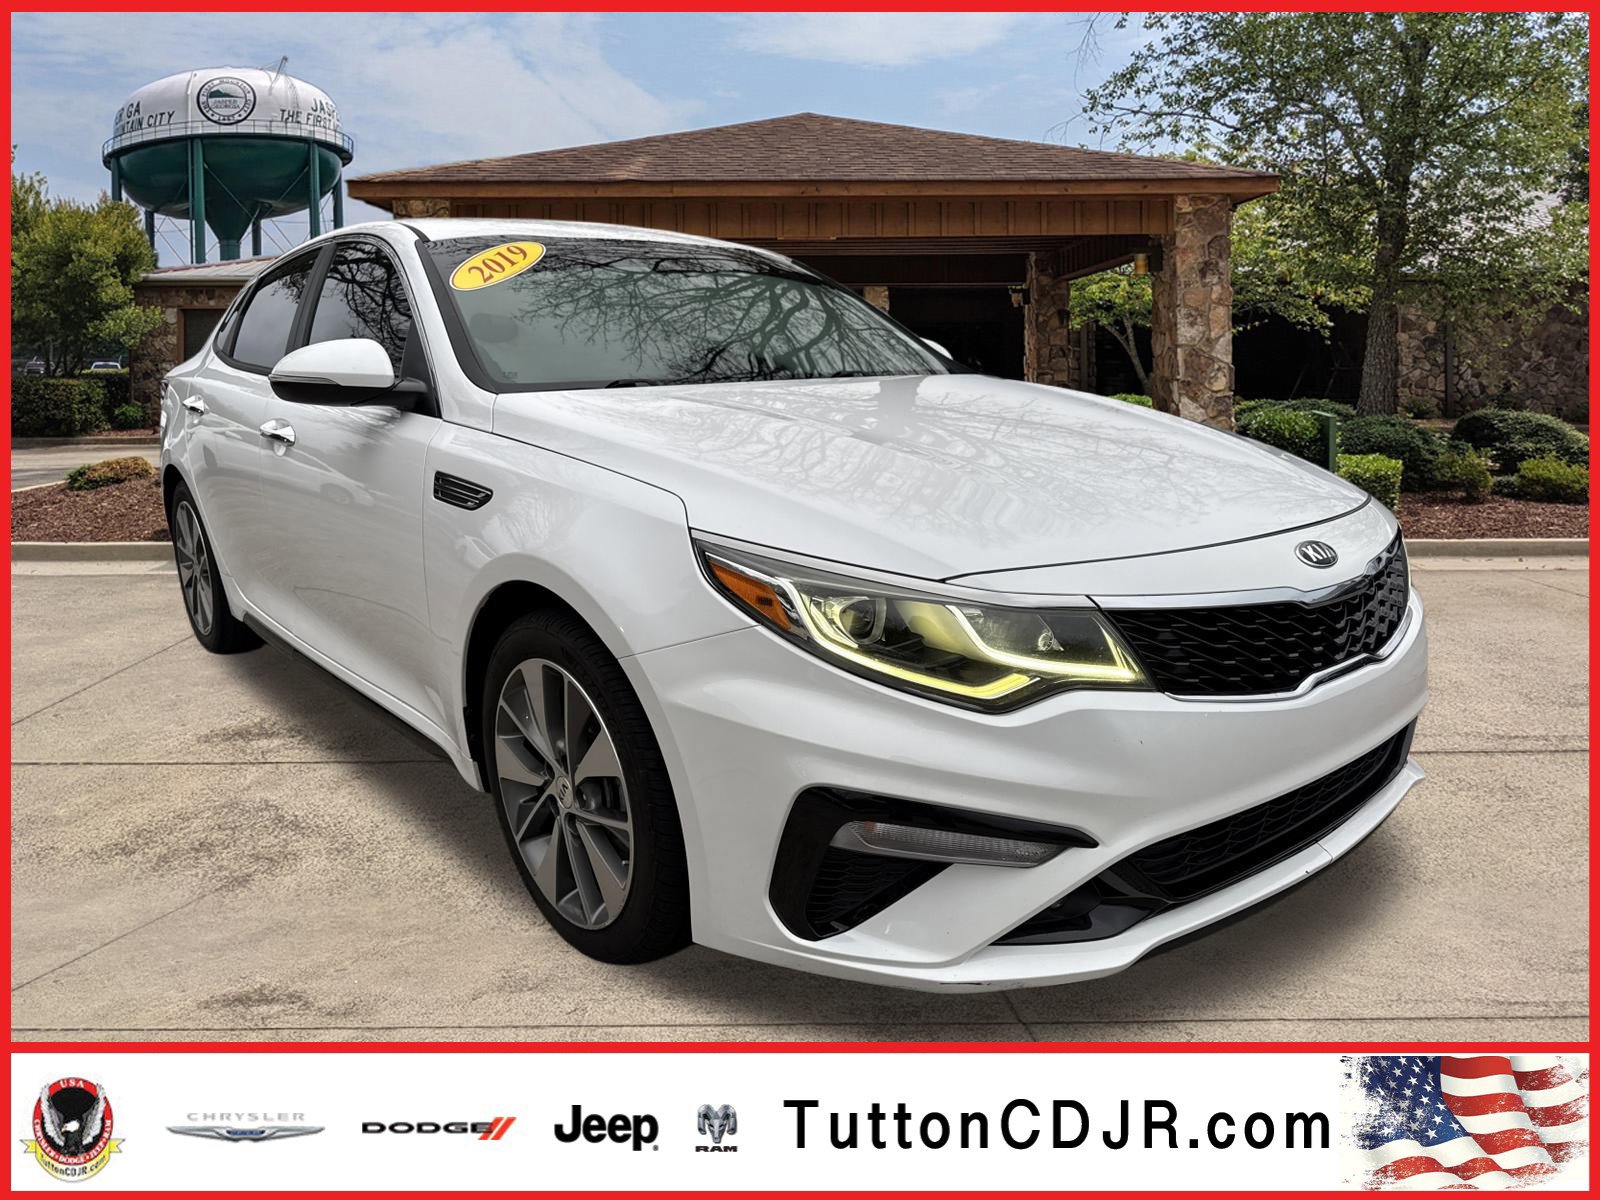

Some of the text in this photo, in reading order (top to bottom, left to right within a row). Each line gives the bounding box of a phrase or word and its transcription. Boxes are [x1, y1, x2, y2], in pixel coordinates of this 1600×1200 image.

[127, 101, 141, 119] GA
[147, 111, 175, 127] CITY
[280, 109, 302, 123] THE
[468, 246, 527, 283] 2019
[1301, 543, 1336, 562] KIA
